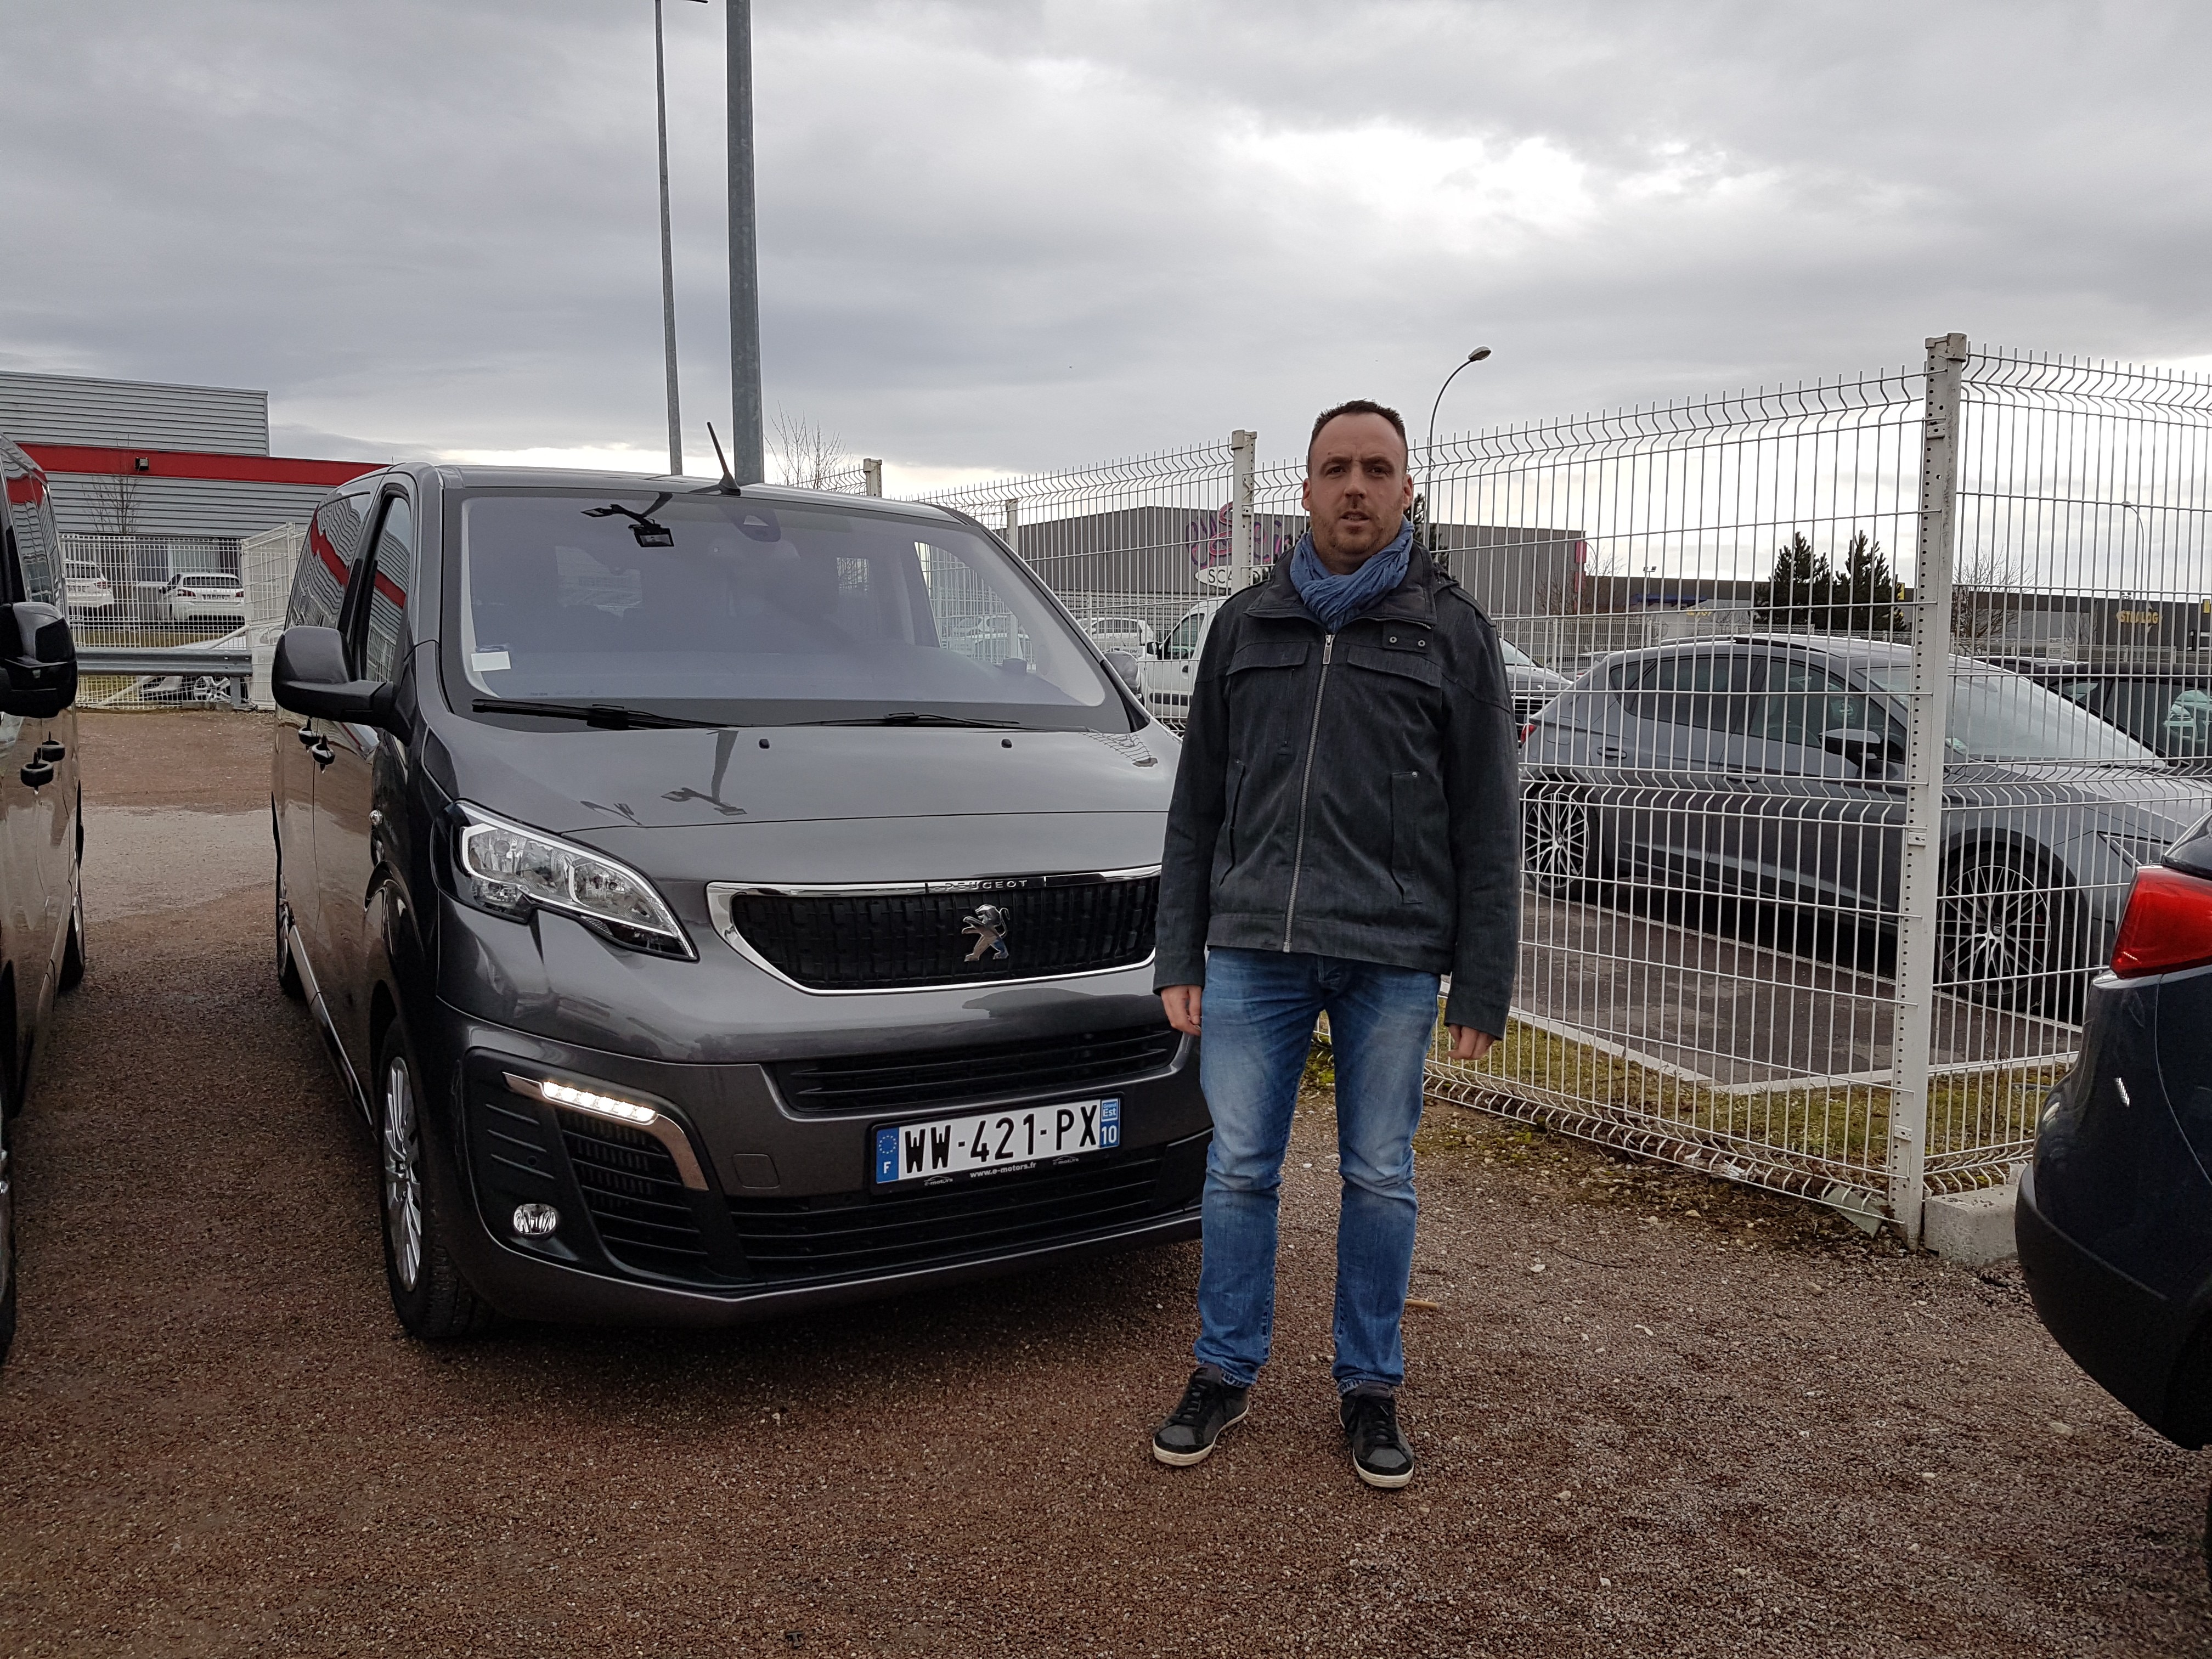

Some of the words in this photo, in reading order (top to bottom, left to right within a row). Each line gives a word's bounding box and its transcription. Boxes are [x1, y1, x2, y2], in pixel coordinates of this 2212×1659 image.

[945, 879, 1028, 891] PEUGEOT
[1103, 1108, 1116, 1117] Est
[904, 1104, 1098, 1173] WW-421-PX
[1101, 1125, 1117, 1144] 10
[883, 1161, 891, 1173] F
[969, 1161, 1037, 1178] www.e-motors.fr
